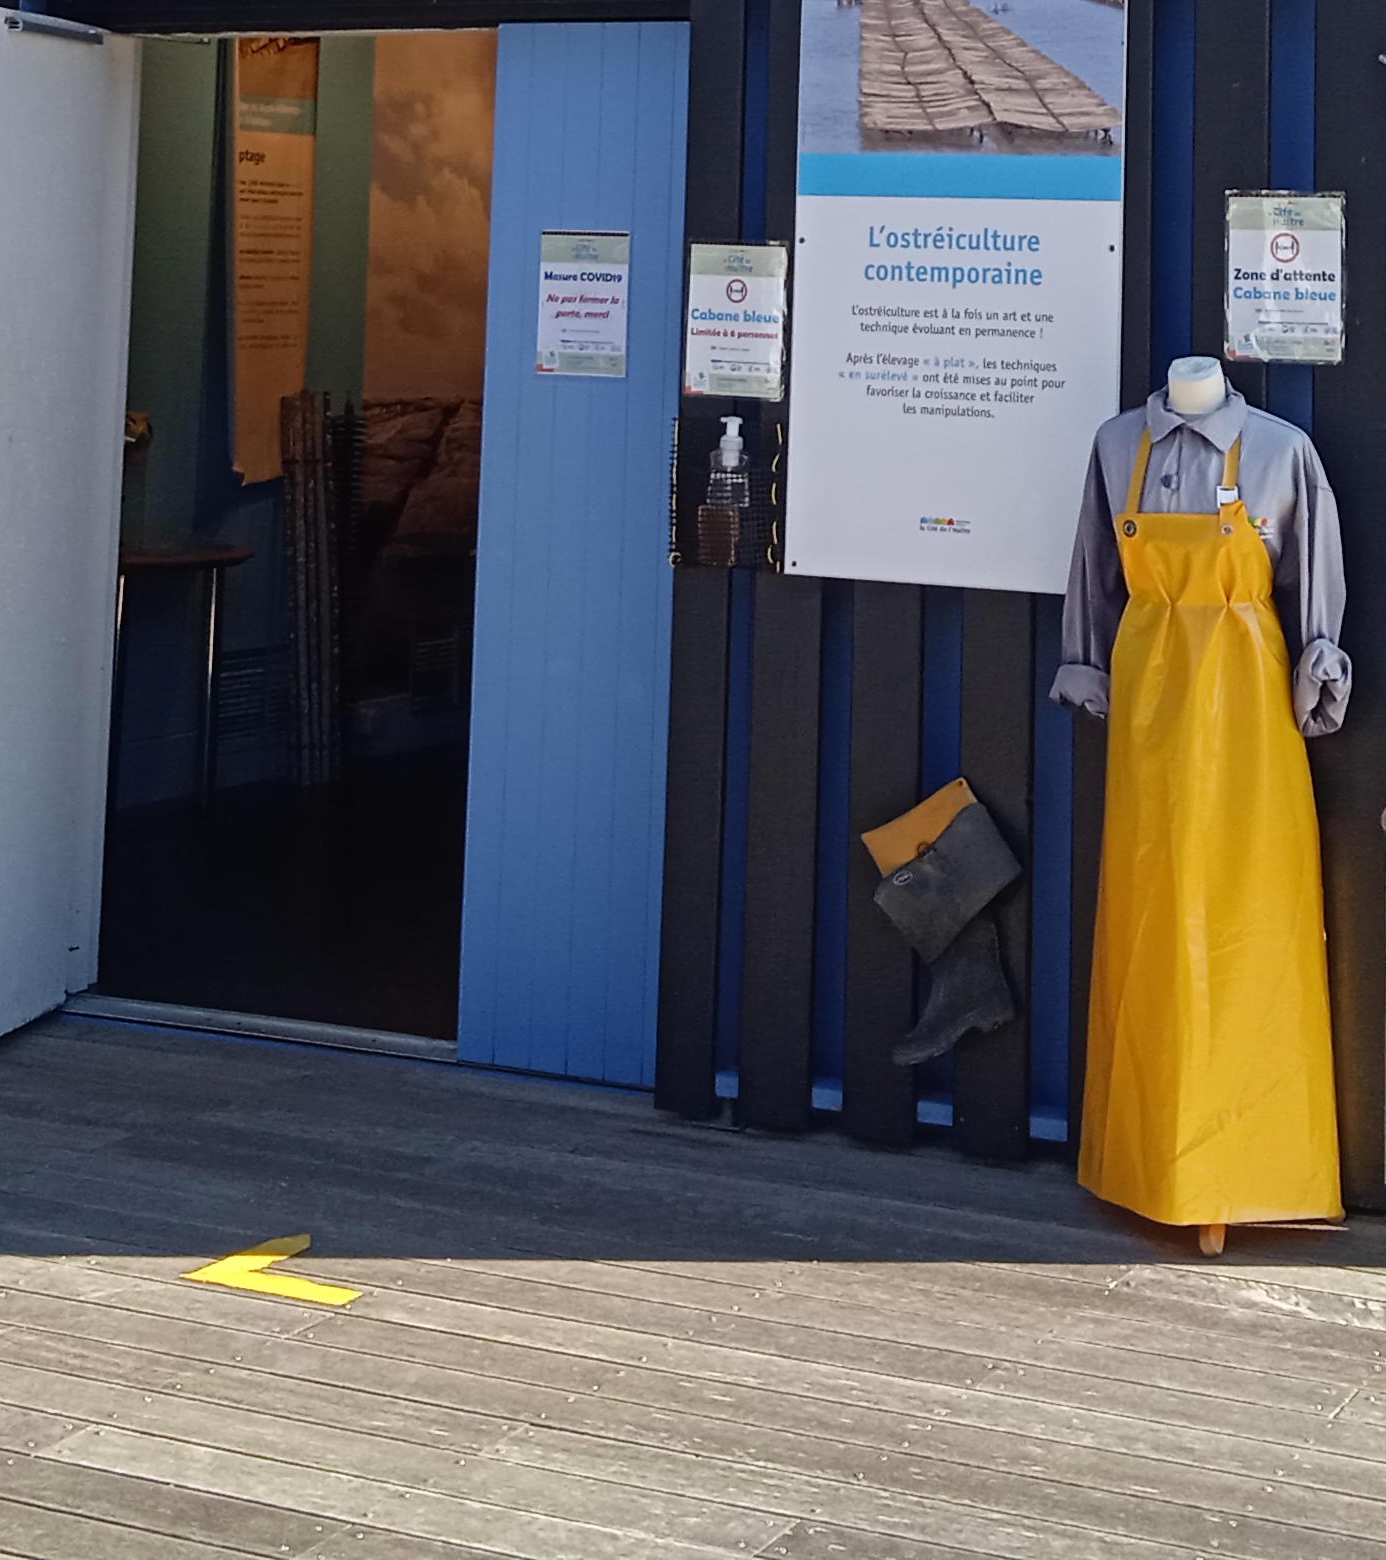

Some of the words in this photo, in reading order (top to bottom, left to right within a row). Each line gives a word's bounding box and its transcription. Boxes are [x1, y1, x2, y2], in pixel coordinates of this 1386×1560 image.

[868, 225, 1041, 252] L'ostréiculture
[580, 272, 623, 283] COVID19
[864, 261, 1043, 289] contemporaine
[1233, 268, 1267, 281] Zone
[1270, 268, 1336, 282] d'attente
[546, 294, 560, 303] Ne
[561, 295, 577, 304] pas
[610, 296, 620, 305] la
[1233, 286, 1291, 301] Cabane
[1294, 287, 1337, 301] bleue
[584, 310, 611, 319] merci
[691, 308, 740, 322] Cabane
[743, 309, 780, 323] bleue
[851, 305, 921, 318] L'ostréiculture
[923, 308, 938, 319] est
[942, 308, 948, 319] à
[951, 308, 961, 320] la
[964, 308, 983, 321] fois
[986, 311, 999, 321] un
[1002, 311, 1018, 322] art
[1020, 312, 1032, 322] et
[1034, 313, 1054, 323] une
[690, 327, 721, 337] Limitée
[723, 329, 729, 337] à
[860, 321, 910, 336] technique
[912, 323, 956, 337] évoluant
[959, 327, 972, 337] en
[974, 327, 1036, 340] permanence
[845, 352, 874, 366] Après
[876, 353, 920, 368] l'élevage
[933, 355, 940, 367] à
[943, 355, 965, 369] plat
[983, 357, 997, 370] les
[1001, 359, 1058, 373] techniques
[849, 371, 861, 380] en
[865, 370, 909, 382] surélevé
[922, 372, 940, 384] ont
[943, 372, 960, 384] été
[963, 374, 991, 386] mises
[994, 376, 1007, 387] au
[1010, 375, 1038, 389] point
[1041, 378, 1066, 390] pour
[866, 384, 909, 398] favoriser
[912, 387, 921, 399] la
[924, 388, 977, 401] croissance
[980, 390, 991, 402] et
[994, 389, 1035, 404] faciliter
[903, 403, 917, 415] les
[920, 405, 995, 419] manipulations.
